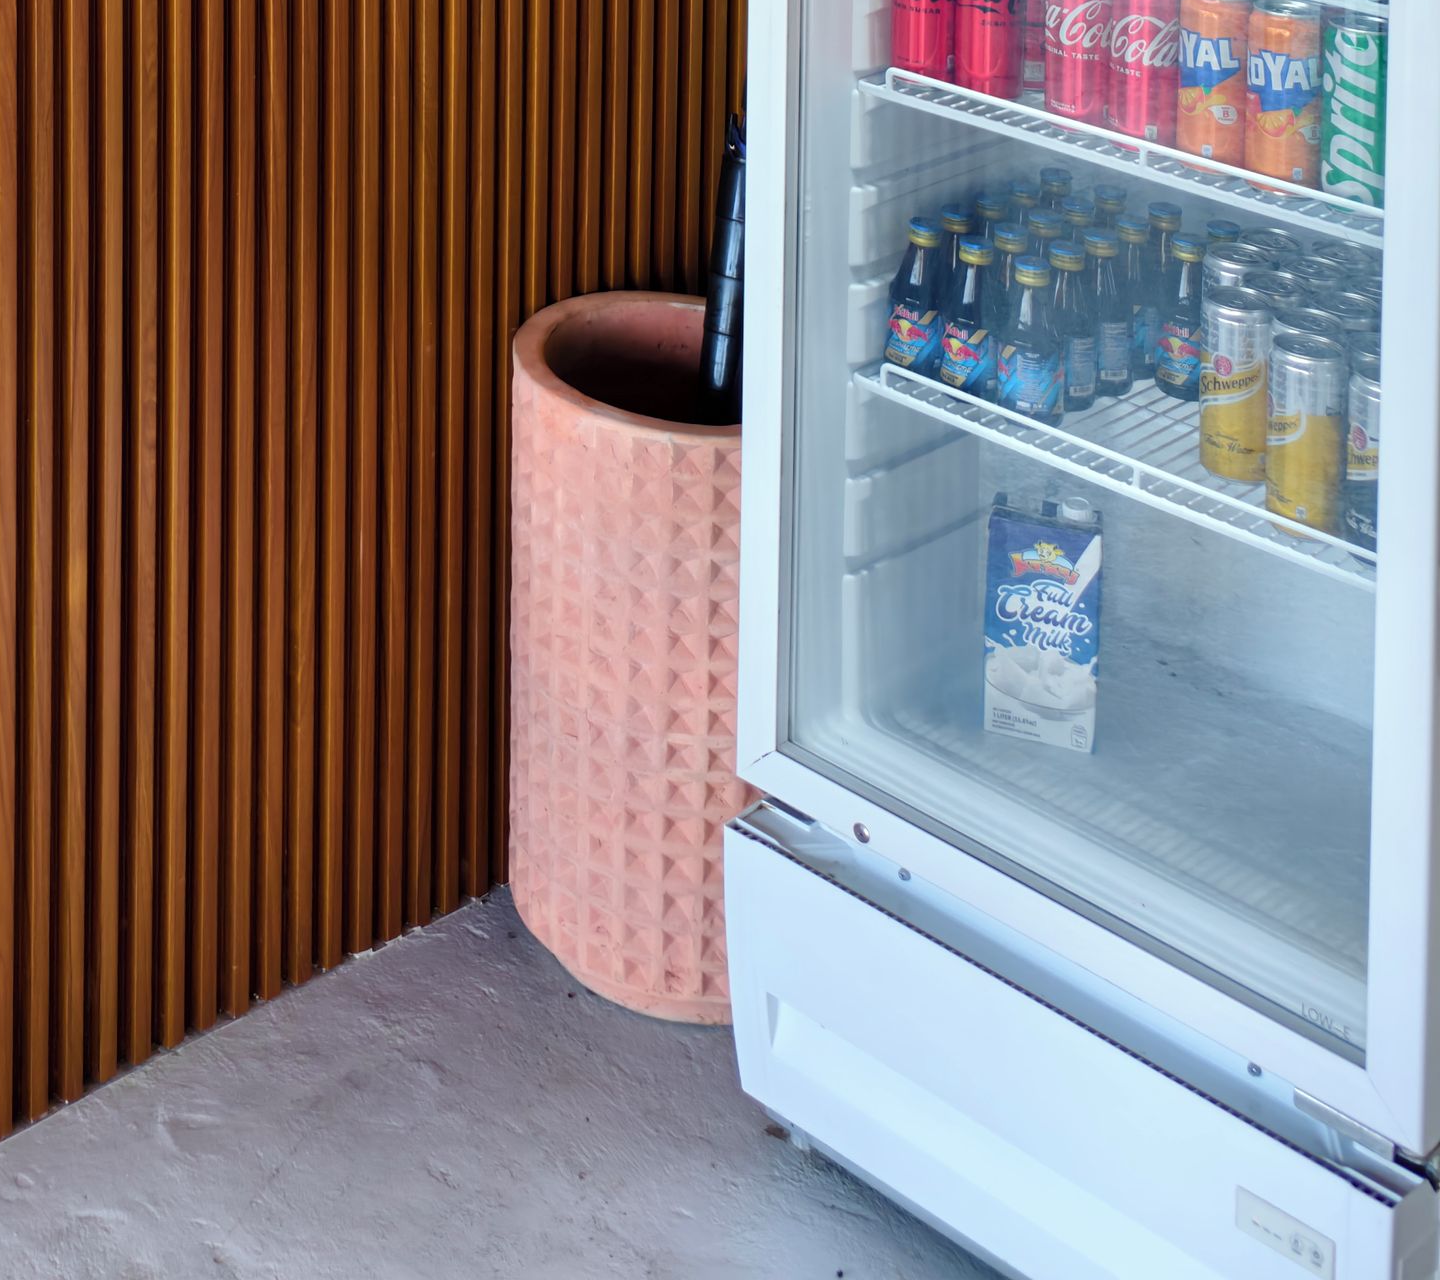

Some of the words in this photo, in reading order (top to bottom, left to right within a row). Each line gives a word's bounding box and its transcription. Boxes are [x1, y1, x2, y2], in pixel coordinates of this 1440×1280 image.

[1072, 52, 1099, 61] TASTE
[1117, 65, 1141, 77] TASTE
[1034, 583, 1072, 608] Full
[998, 587, 1090, 633] Cream
[1024, 622, 1072, 656] Milk
